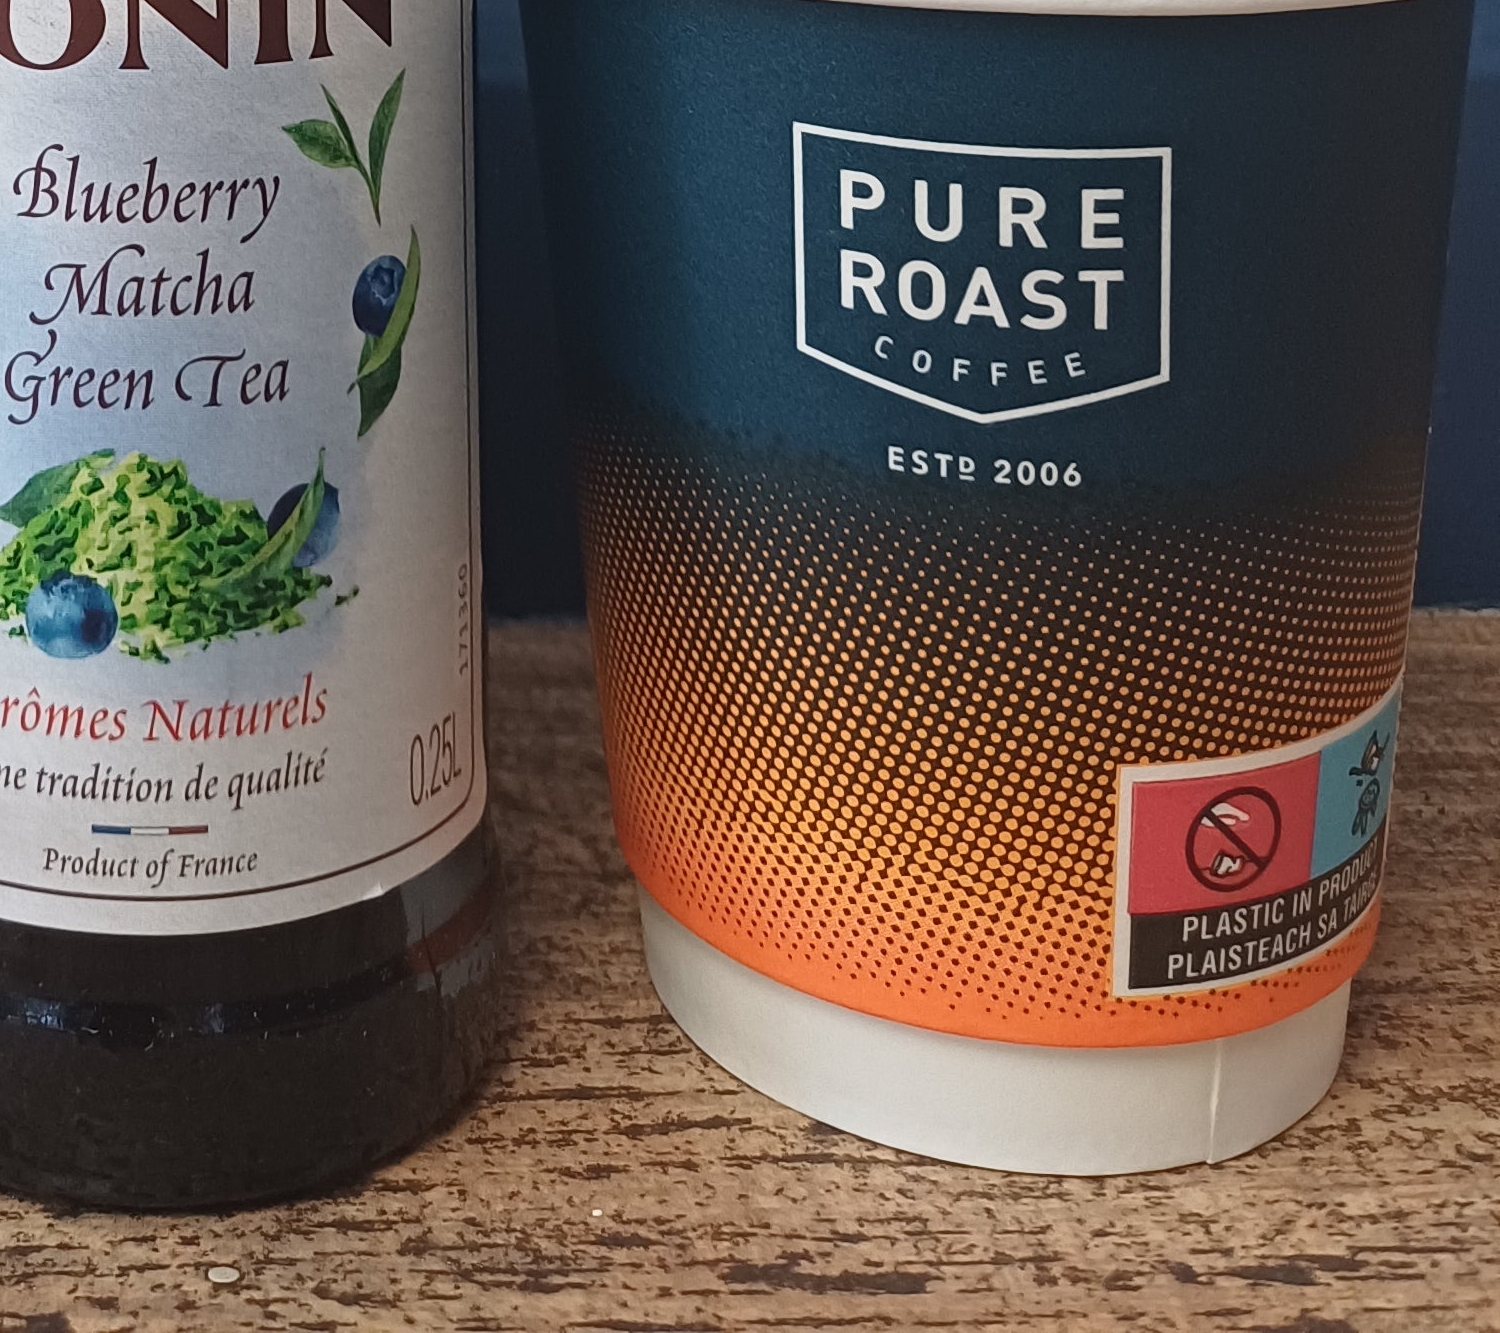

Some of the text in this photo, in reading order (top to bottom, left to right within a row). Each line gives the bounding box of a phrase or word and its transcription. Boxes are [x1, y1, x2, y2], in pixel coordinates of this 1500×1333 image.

[12, 143, 281, 244] Blueberry
[839, 168, 1125, 249] PURE
[28, 244, 256, 325] Matcha
[839, 248, 1125, 331] ROAST
[4, 329, 291, 426] Green Tea
[873, 334, 1086, 387] COFFEE
[993, 458, 1083, 488] 2006
[141, 671, 329, 742] Naturels
[35, 758, 174, 804] tradition
[183, 763, 219, 801] de
[227, 746, 328, 811] qualité
[410, 711, 462, 807] 0.25L
[42, 846, 259, 890] Product of France
[1166, 920, 1312, 980] PLAISTEACH
[1317, 906, 1338, 939] SA
[1181, 898, 1285, 943] PLASTIC
[1292, 886, 1313, 918] IN
